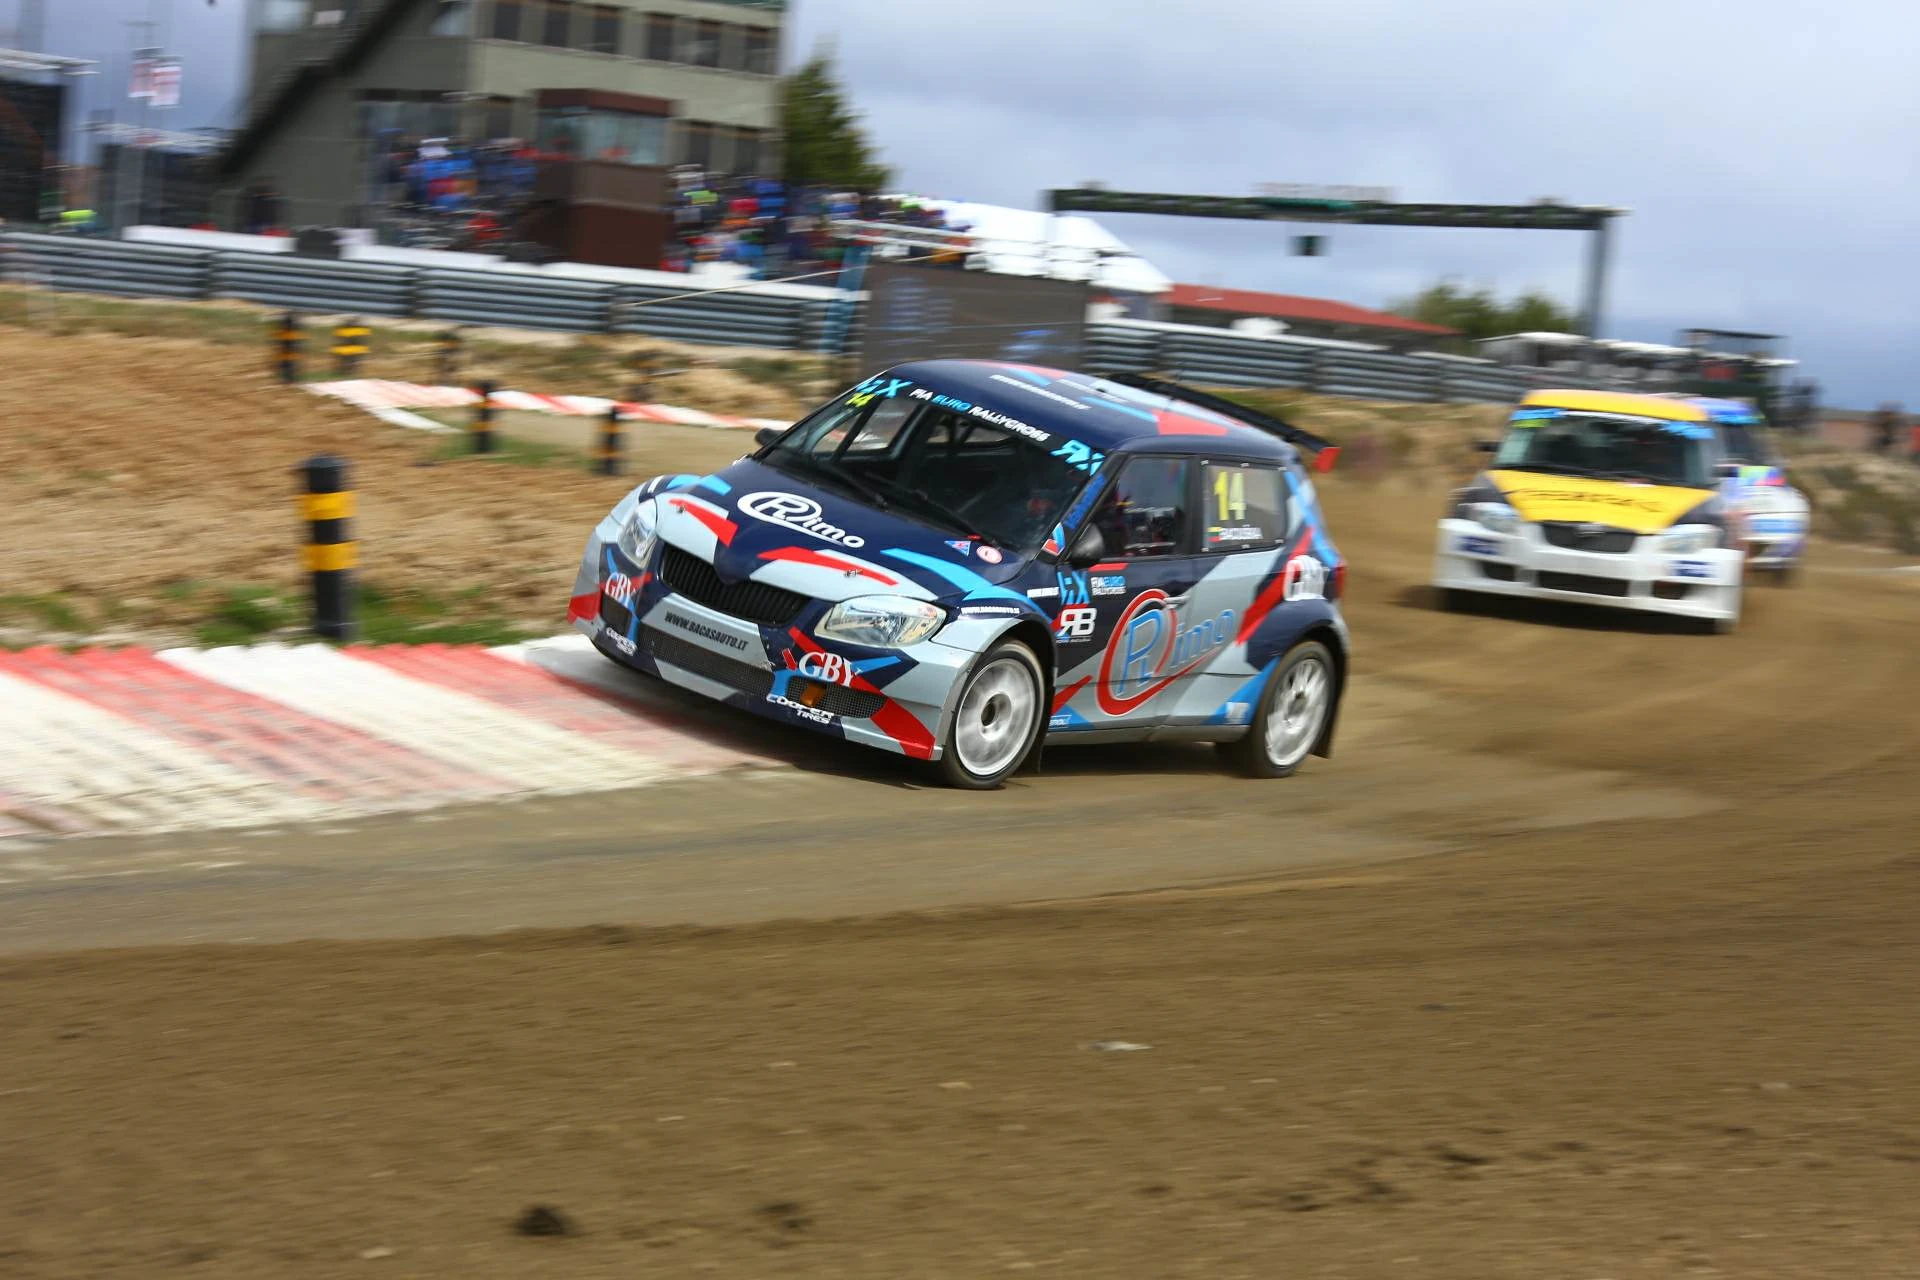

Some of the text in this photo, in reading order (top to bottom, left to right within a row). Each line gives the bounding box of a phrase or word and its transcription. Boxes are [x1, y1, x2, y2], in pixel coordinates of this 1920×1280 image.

[909, 388, 1051, 442] FIA EURO RALLYCROSS
[737, 488, 865, 548] Rimo
[1214, 471, 1247, 520] 14
[798, 651, 863, 688] GBY
[1106, 600, 1235, 706] Rimo
[766, 693, 835, 720] COOPER
[796, 709, 830, 724] TIRES
